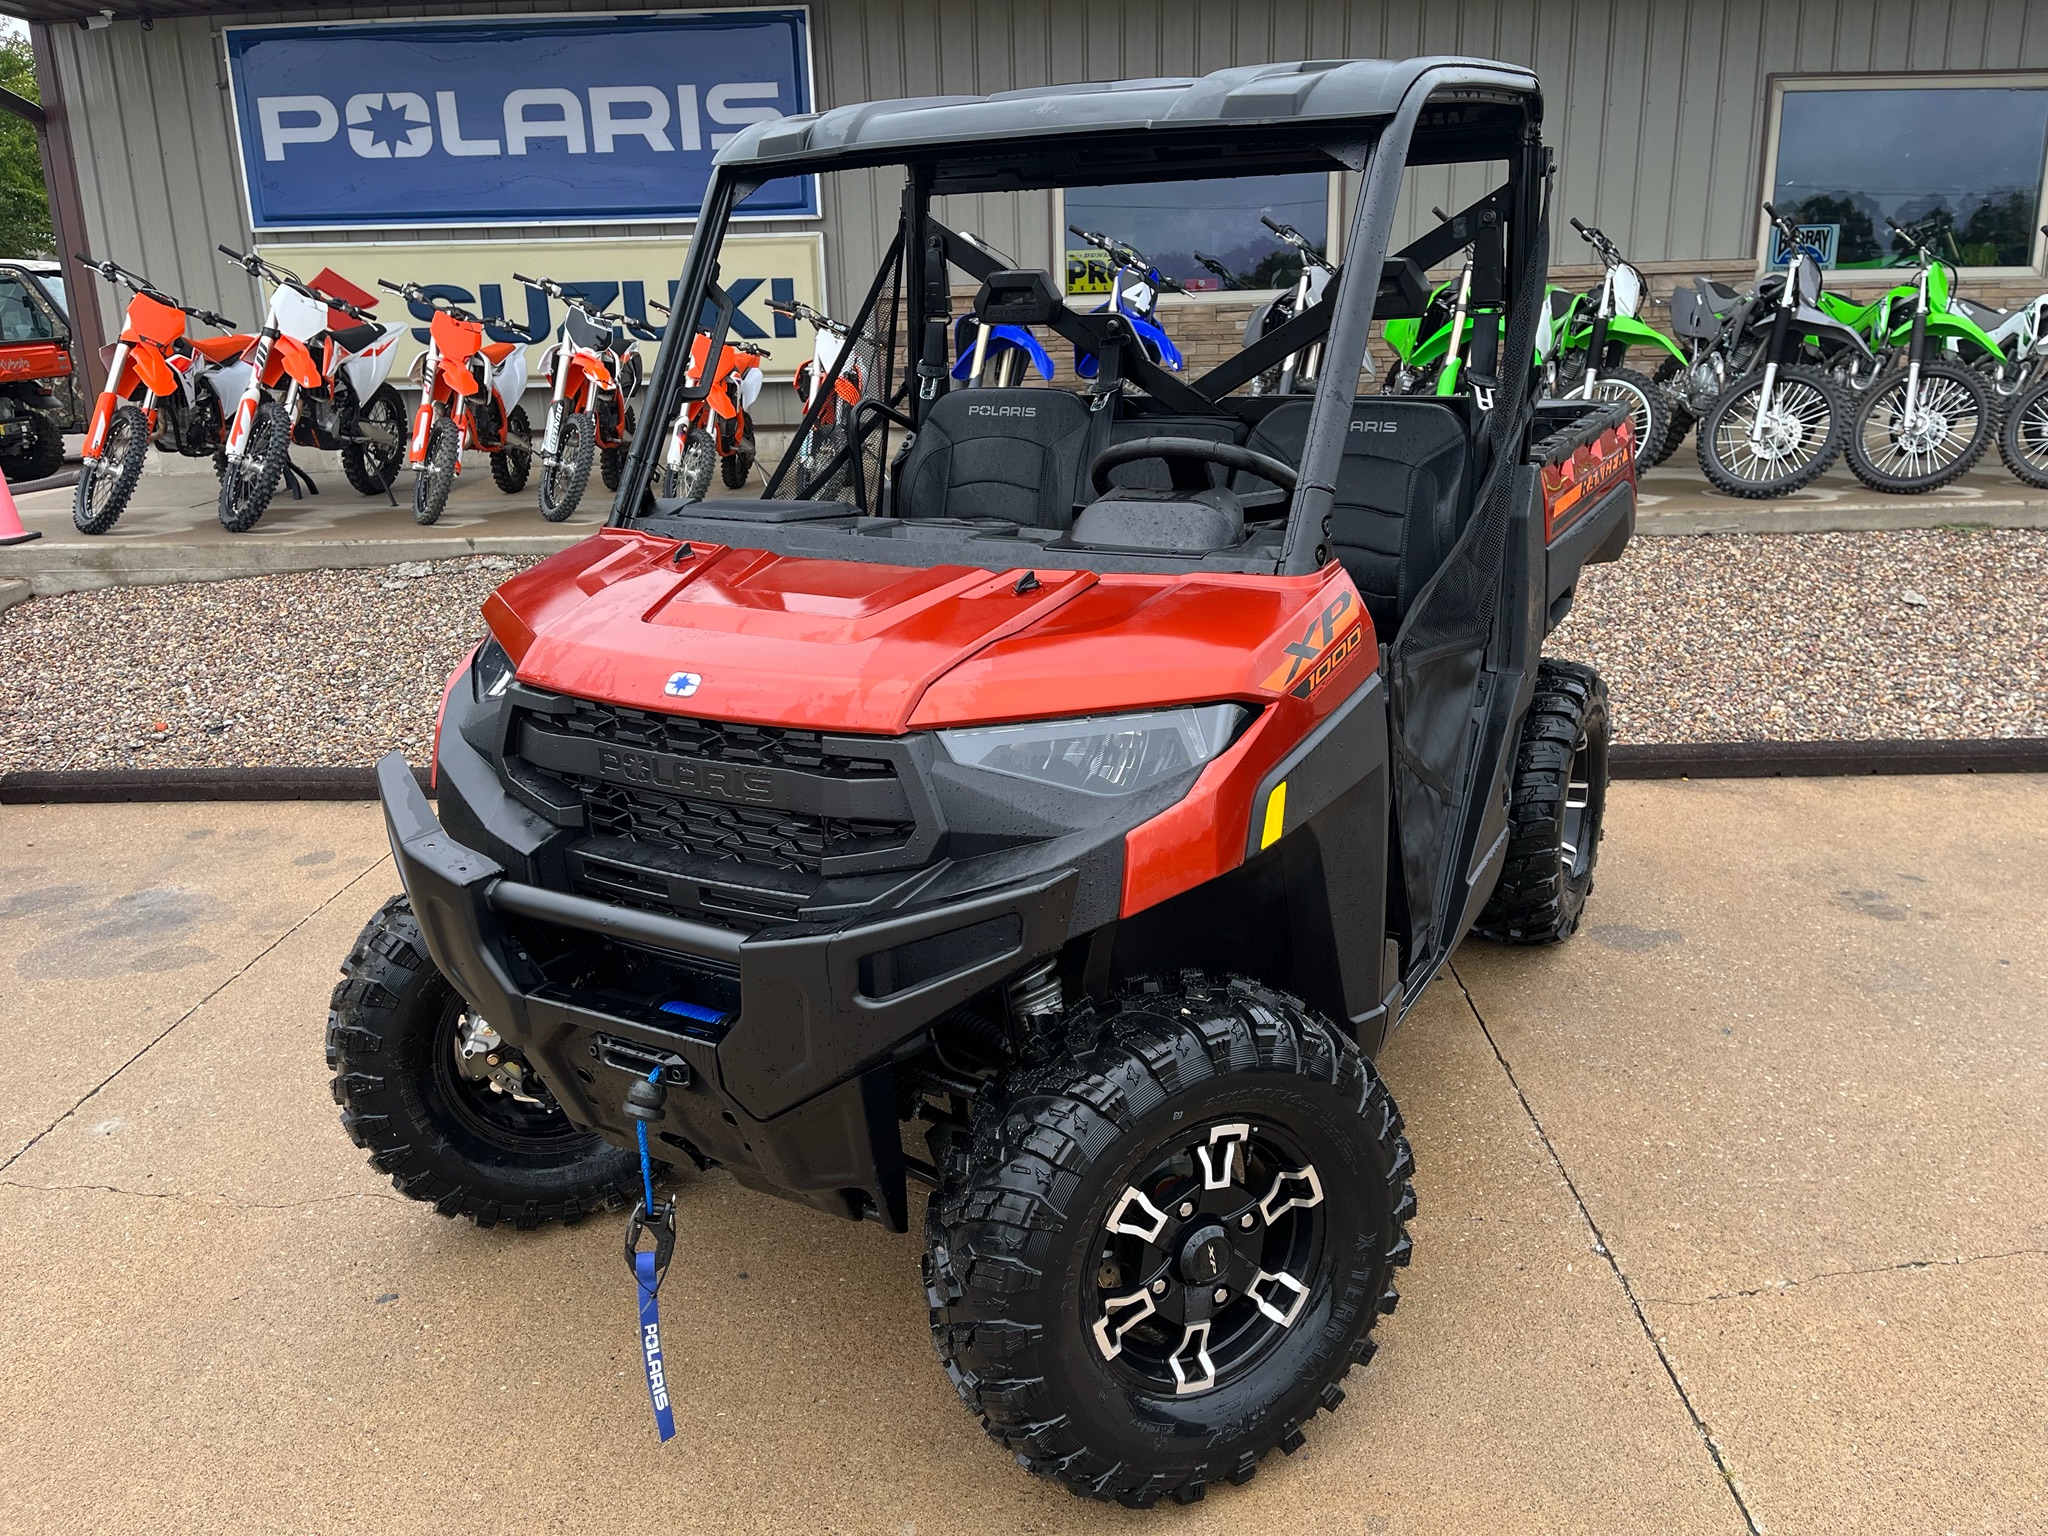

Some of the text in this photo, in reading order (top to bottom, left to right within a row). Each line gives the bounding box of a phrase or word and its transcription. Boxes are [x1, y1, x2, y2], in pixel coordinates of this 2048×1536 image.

[257, 82, 784, 161] POLARIS
[407, 278, 797, 345] SUZUKI
[968, 405, 1037, 418] POLARIS
[1349, 420, 1398, 433] ARIS
[1282, 590, 1352, 688] XP
[1308, 626, 1362, 692] 1000
[598, 747, 776, 803] POLARIS
[1207, 1244, 1217, 1275] XP
[1292, 1231, 1378, 1390] X-TERRAIN
[644, 1323, 669, 1411] POLARIS
